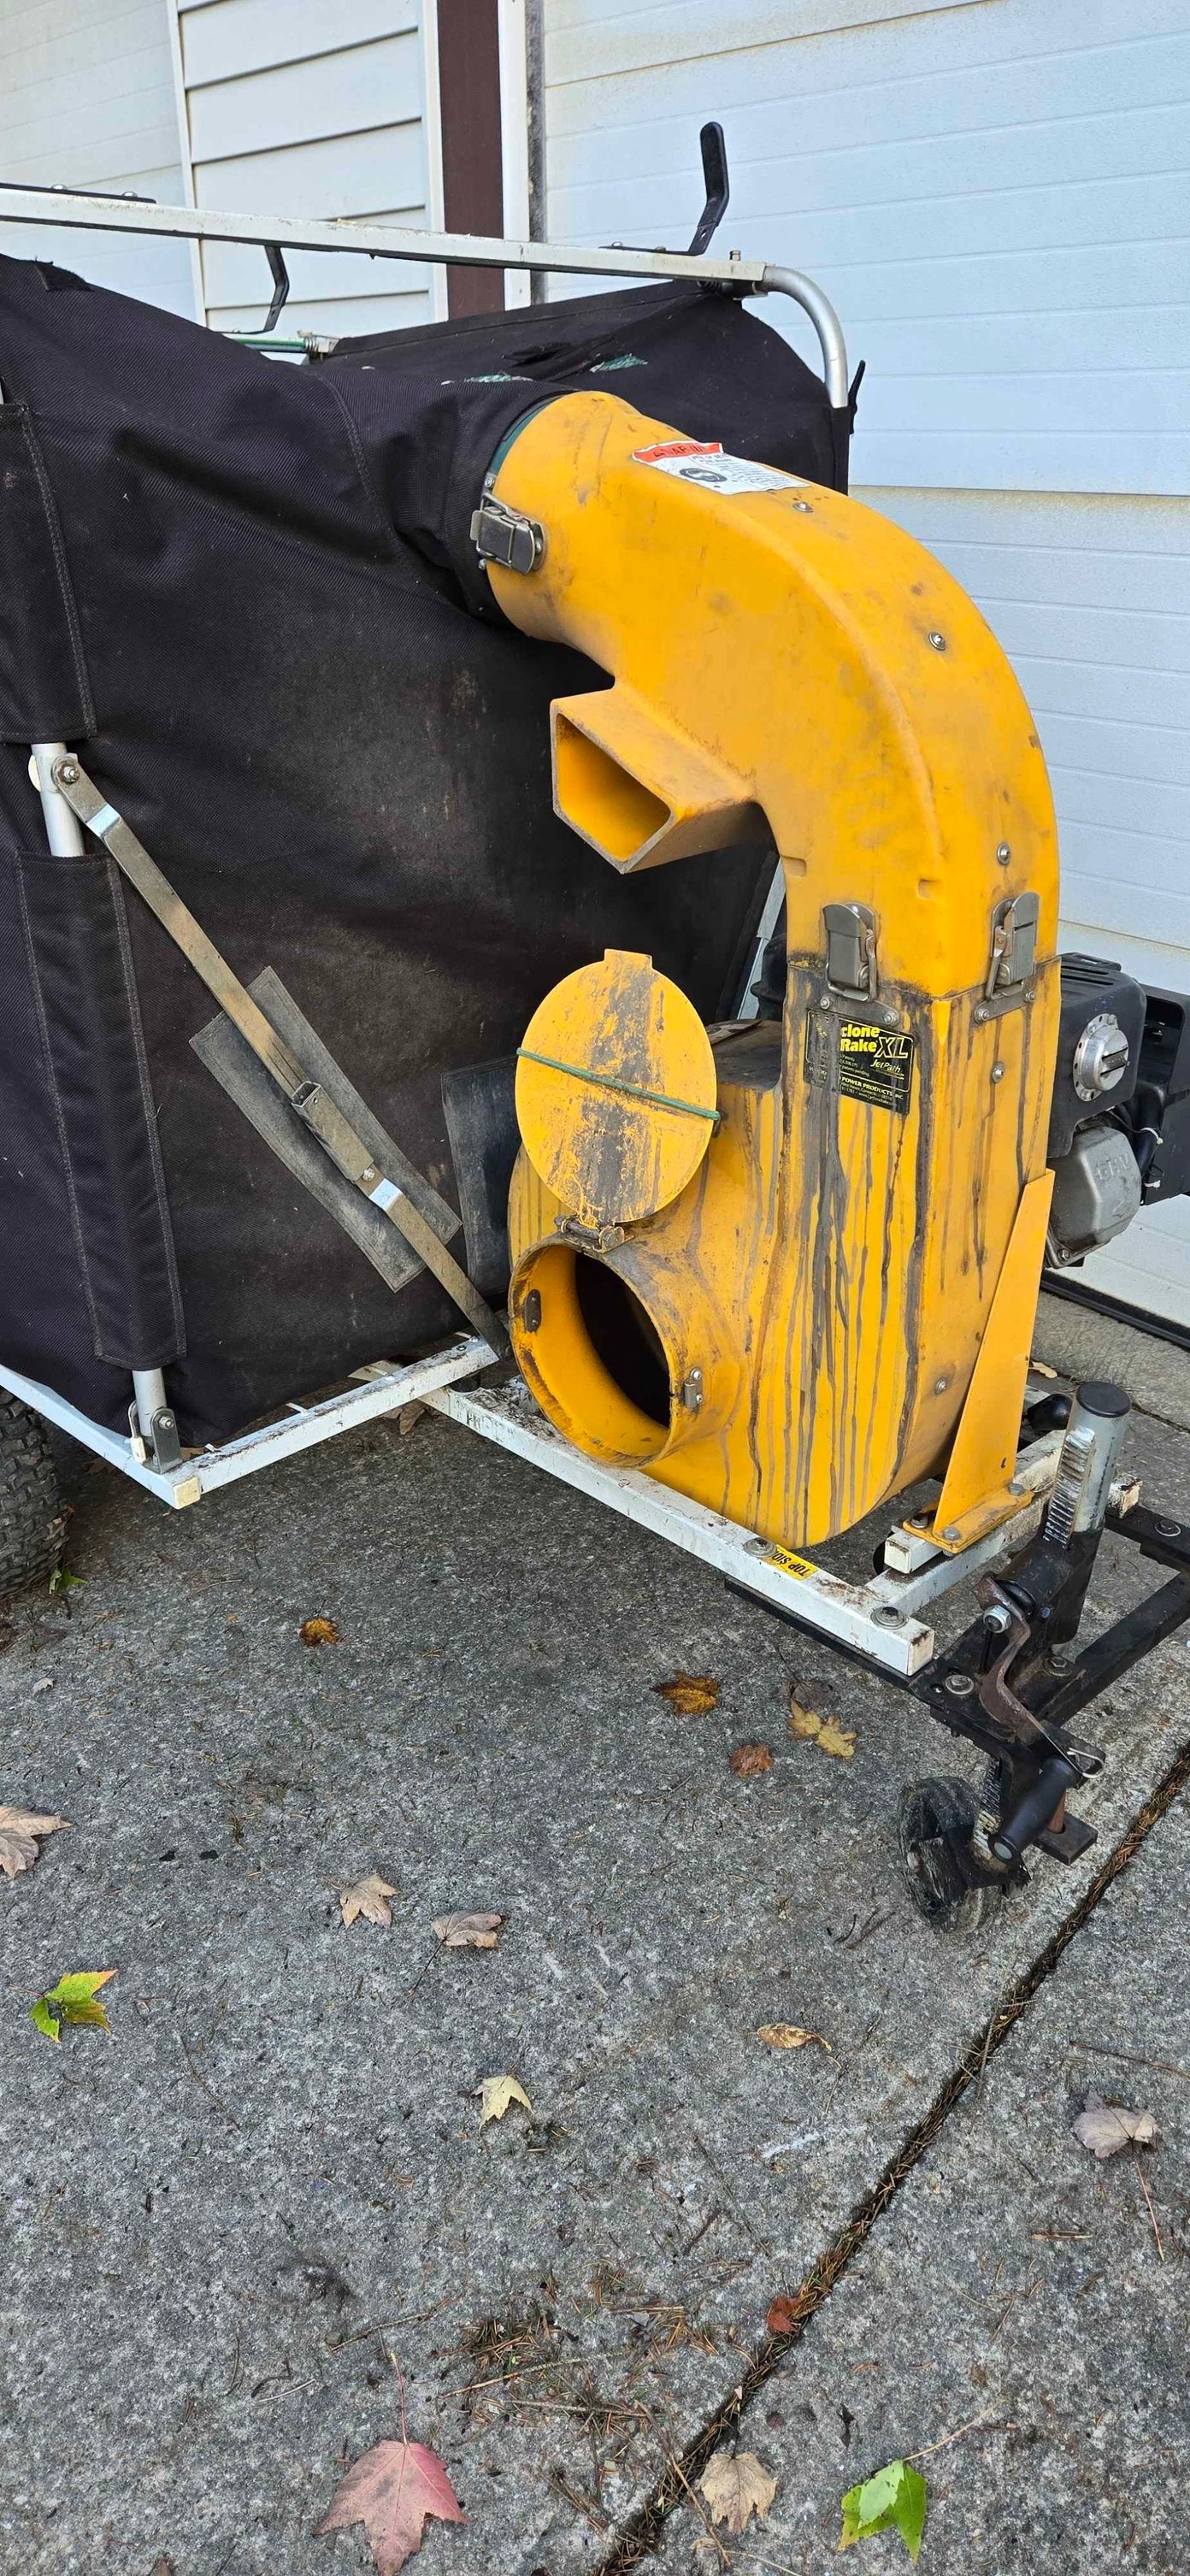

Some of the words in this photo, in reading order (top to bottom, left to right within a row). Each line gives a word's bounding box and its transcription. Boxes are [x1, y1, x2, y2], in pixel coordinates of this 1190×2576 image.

[840, 1038, 877, 1052] Rake
[874, 1037, 908, 1058] XL
[870, 1059, 901, 1073] JetPath
[841, 1076, 863, 1088] POWER
[772, 1551, 792, 1565] SID
[788, 1563, 810, 1577] TOP
